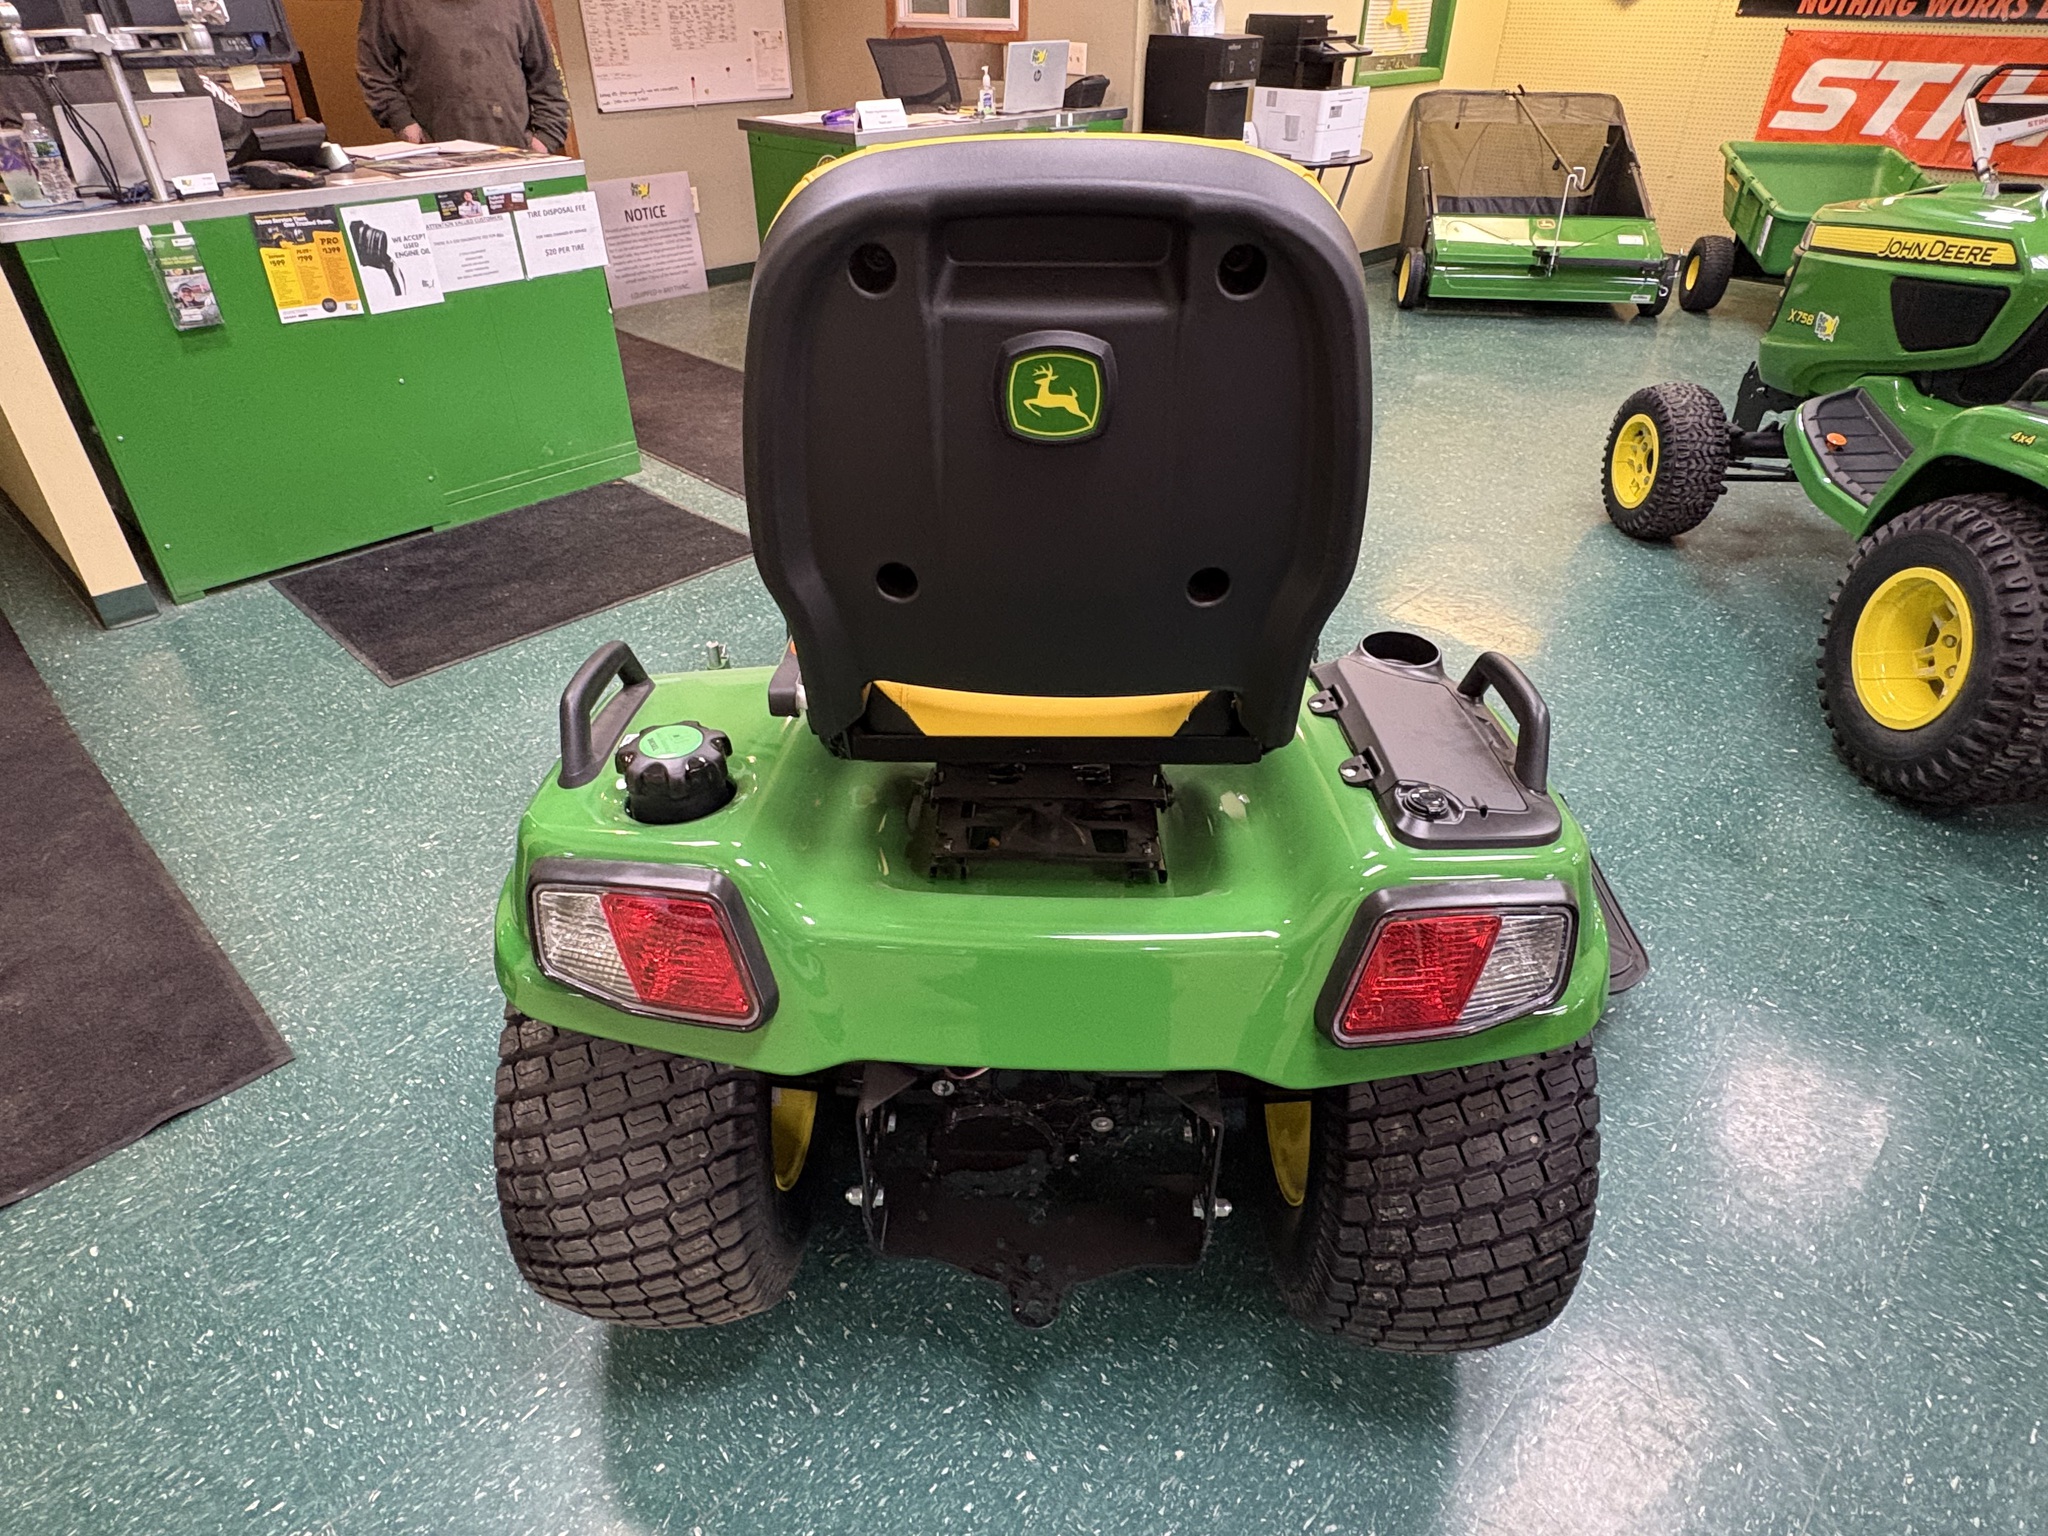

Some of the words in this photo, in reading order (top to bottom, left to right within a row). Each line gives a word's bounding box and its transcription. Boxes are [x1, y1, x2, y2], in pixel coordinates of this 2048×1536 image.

[1796, 0, 1918, 18] NOTHING
[1924, 0, 2029, 20] WORKS
[527, 210, 541, 219] TIRE
[543, 206, 574, 217] DISPOSAL
[575, 204, 586, 212] FEE
[624, 205, 667, 223] NOTICE
[320, 237, 339, 245] PRO
[403, 233, 426, 243] ACCEPT
[395, 250, 420, 259] ENGINE
[545, 247, 557, 257] $20
[571, 243, 585, 251] TIRE
[1878, 237, 1928, 257] JOHN
[1927, 240, 1998, 263] DEERE
[1787, 308, 1815, 326] X758
[2010, 431, 2037, 446] 4x4
